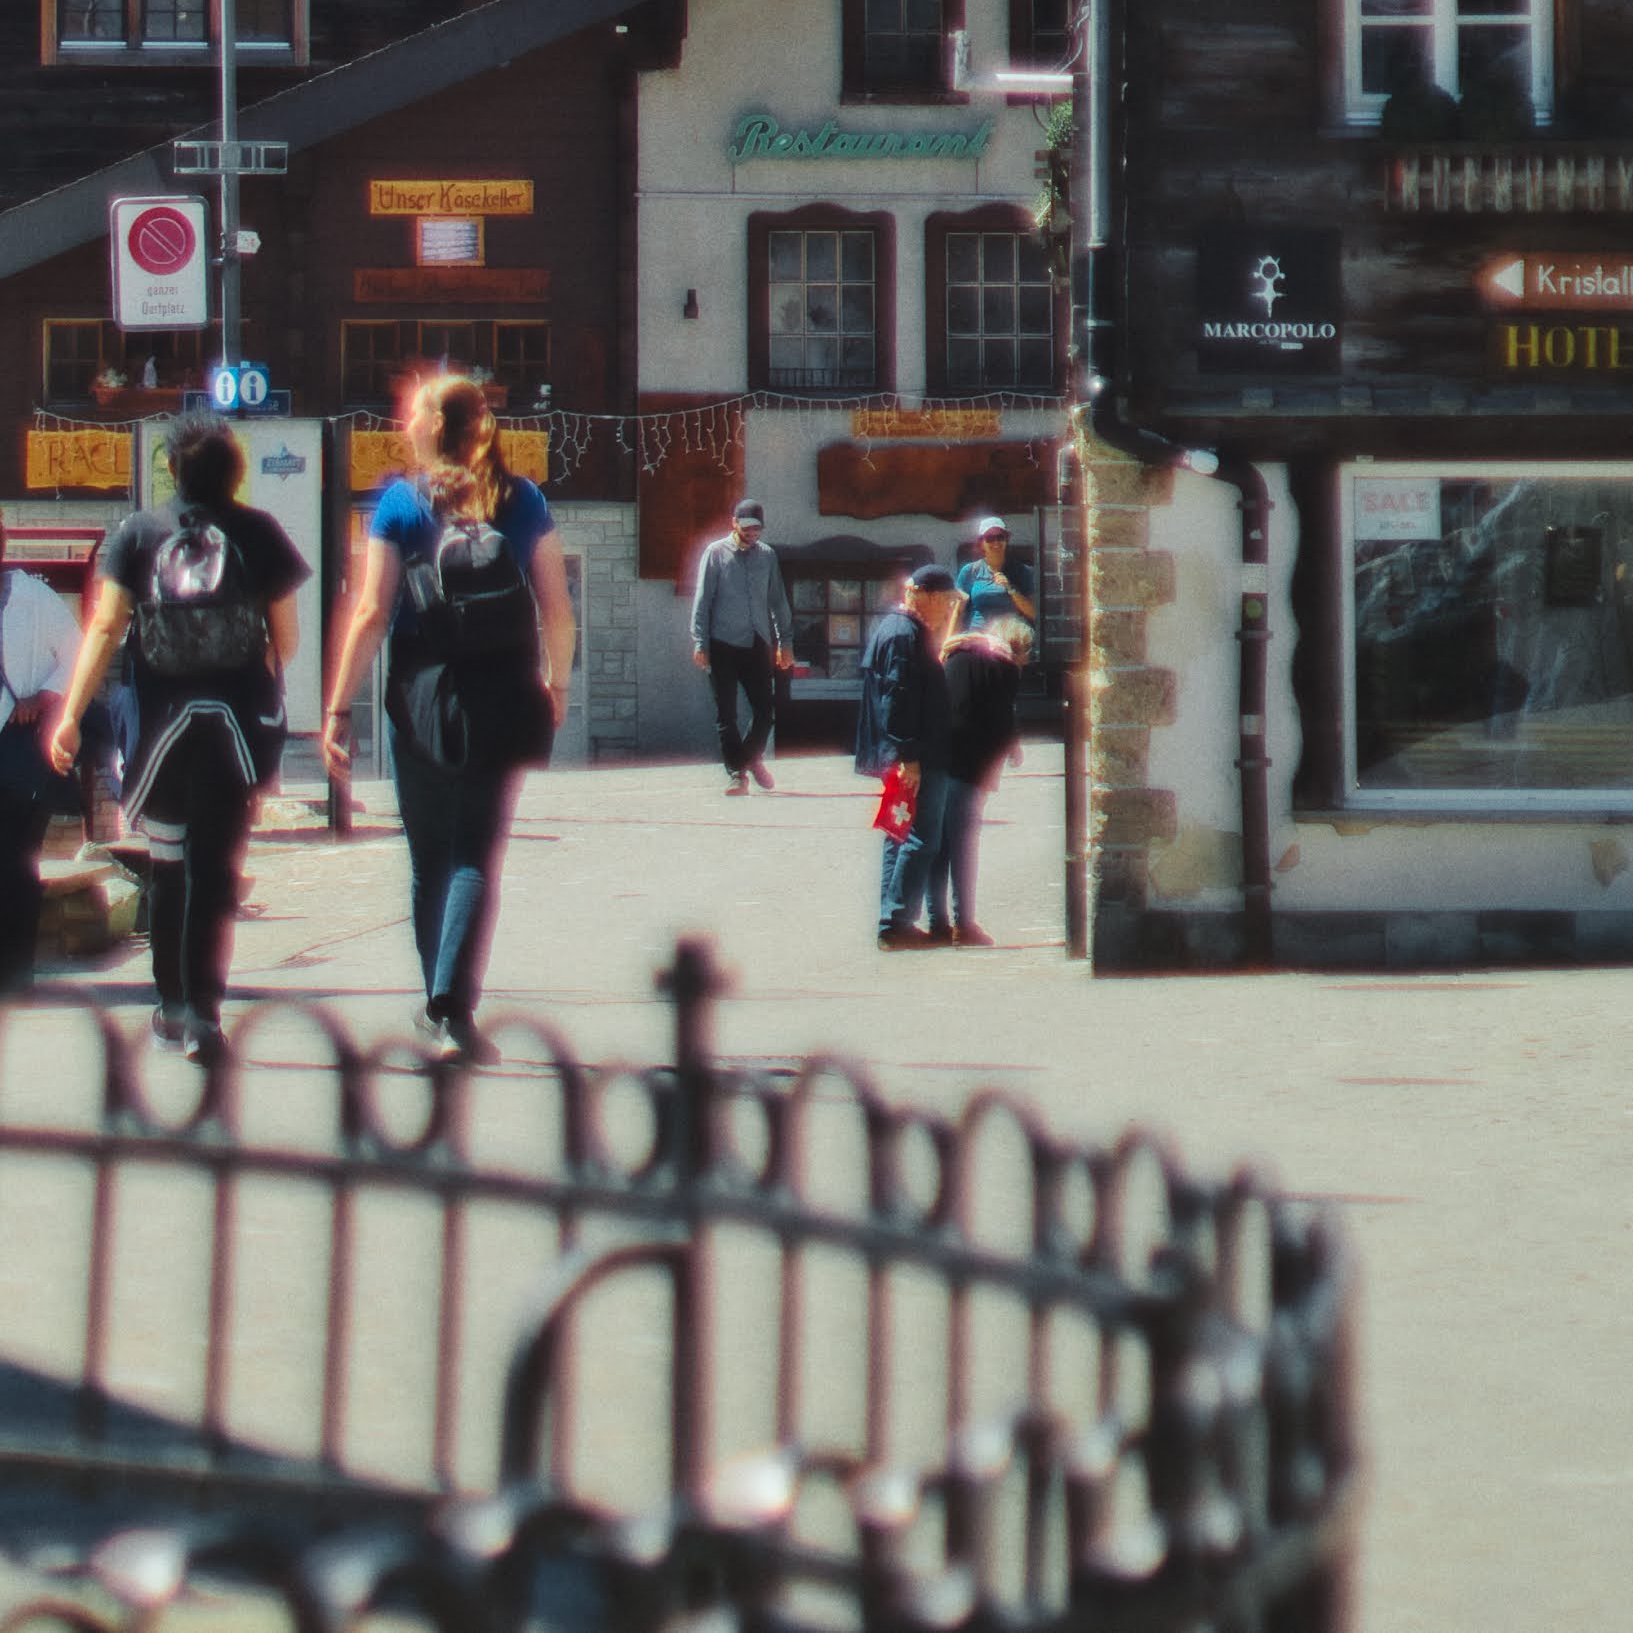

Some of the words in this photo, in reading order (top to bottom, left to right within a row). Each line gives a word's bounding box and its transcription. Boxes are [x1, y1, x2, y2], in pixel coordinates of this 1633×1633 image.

[728, 113, 996, 167] Restaurant
[378, 182, 435, 210] Unser
[147, 285, 179, 298] ganzer
[1203, 322, 1337, 339] MARCOPOLO
